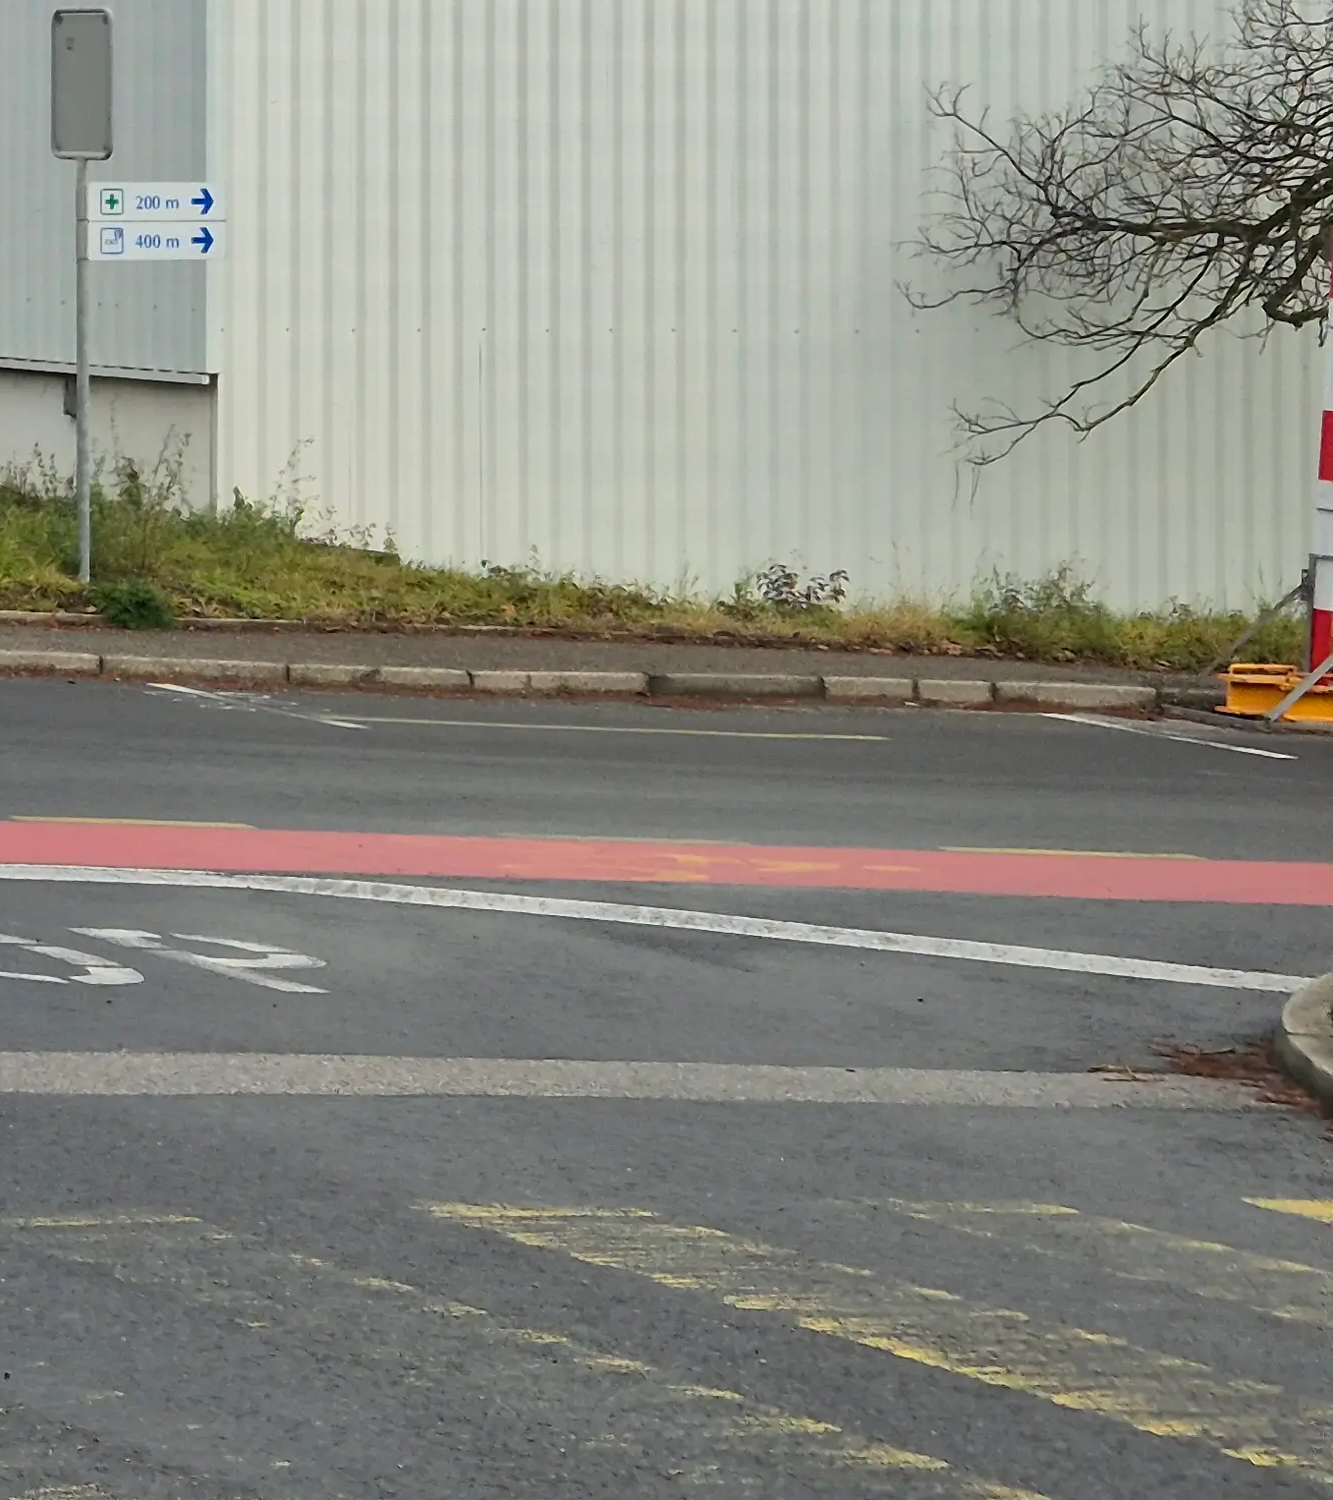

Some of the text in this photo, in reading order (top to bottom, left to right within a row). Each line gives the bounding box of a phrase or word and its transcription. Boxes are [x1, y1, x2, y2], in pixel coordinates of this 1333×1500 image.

[135, 195, 180, 210] 200 m
[135, 234, 161, 249] 400
[166, 237, 180, 249] m
